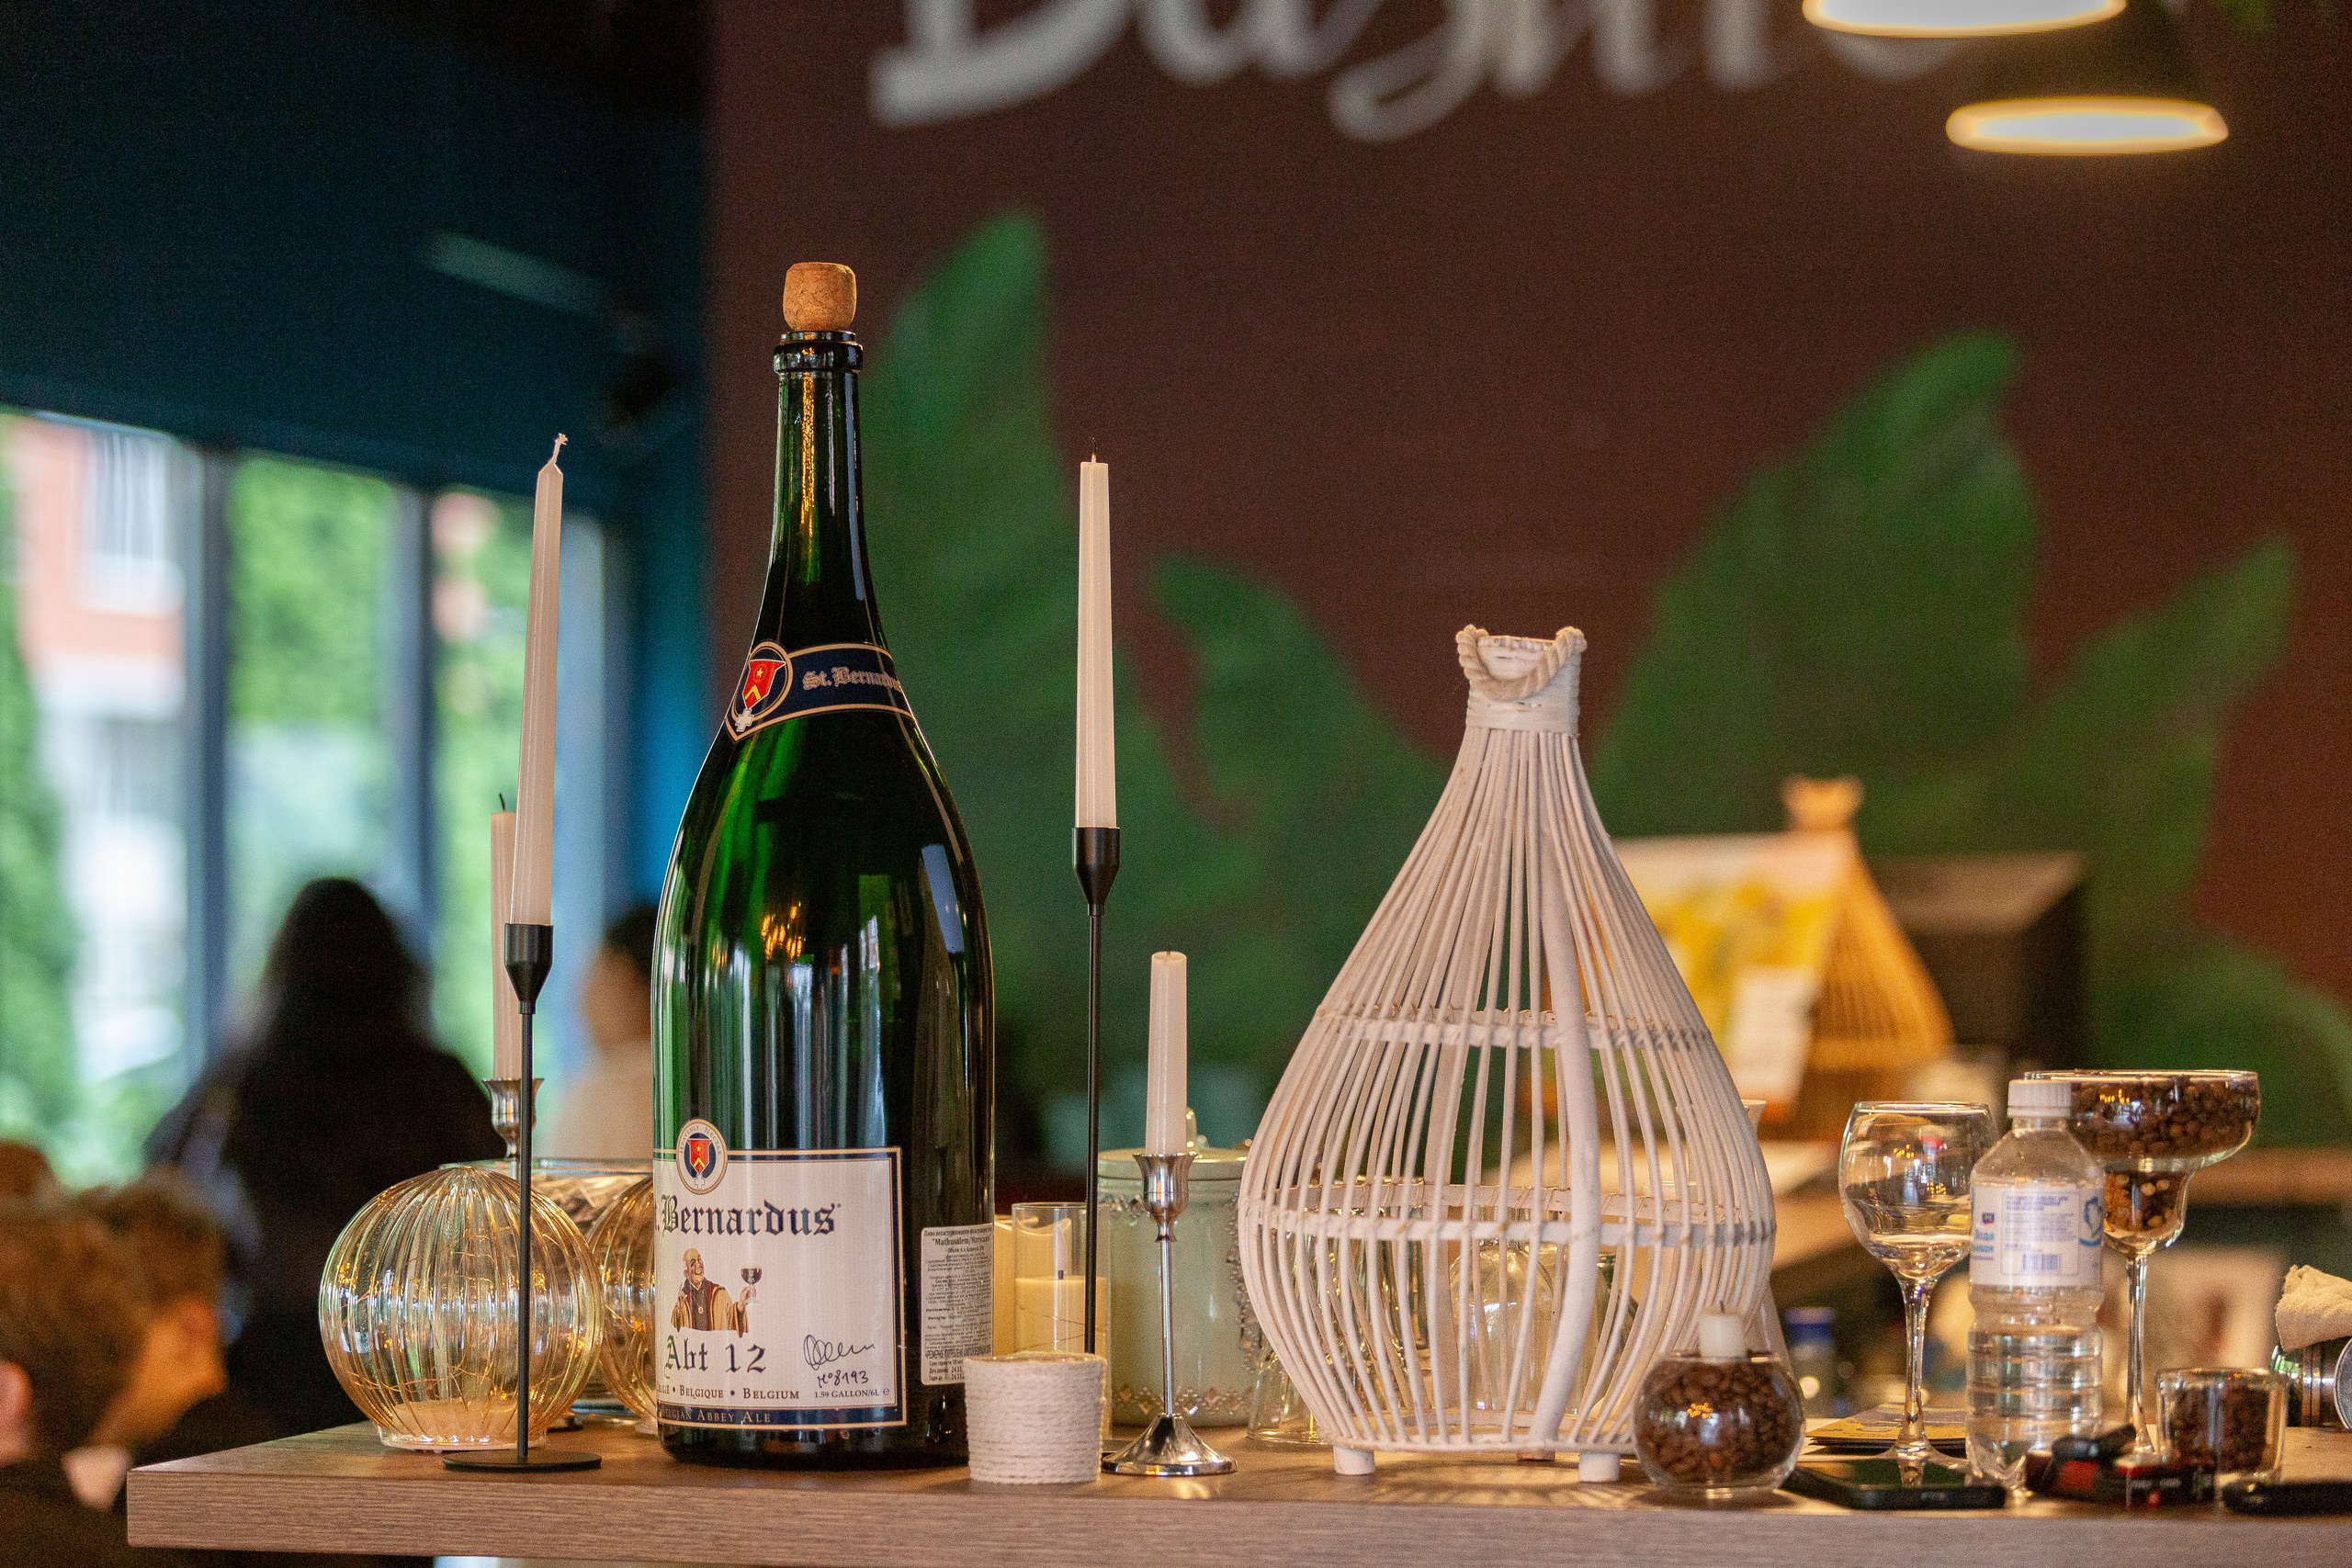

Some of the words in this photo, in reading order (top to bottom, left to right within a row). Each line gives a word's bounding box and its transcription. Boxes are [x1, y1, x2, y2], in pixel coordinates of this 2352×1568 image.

[802, 671, 832, 691] St.
[705, 1126, 722, 1156] NECTAR
[662, 1194, 835, 1237] Bernardus
[664, 1335, 708, 1379] Abt
[726, 1343, 766, 1373] 12
[697, 1409, 735, 1422] ABBEY
[741, 1410, 771, 1423] ALE
